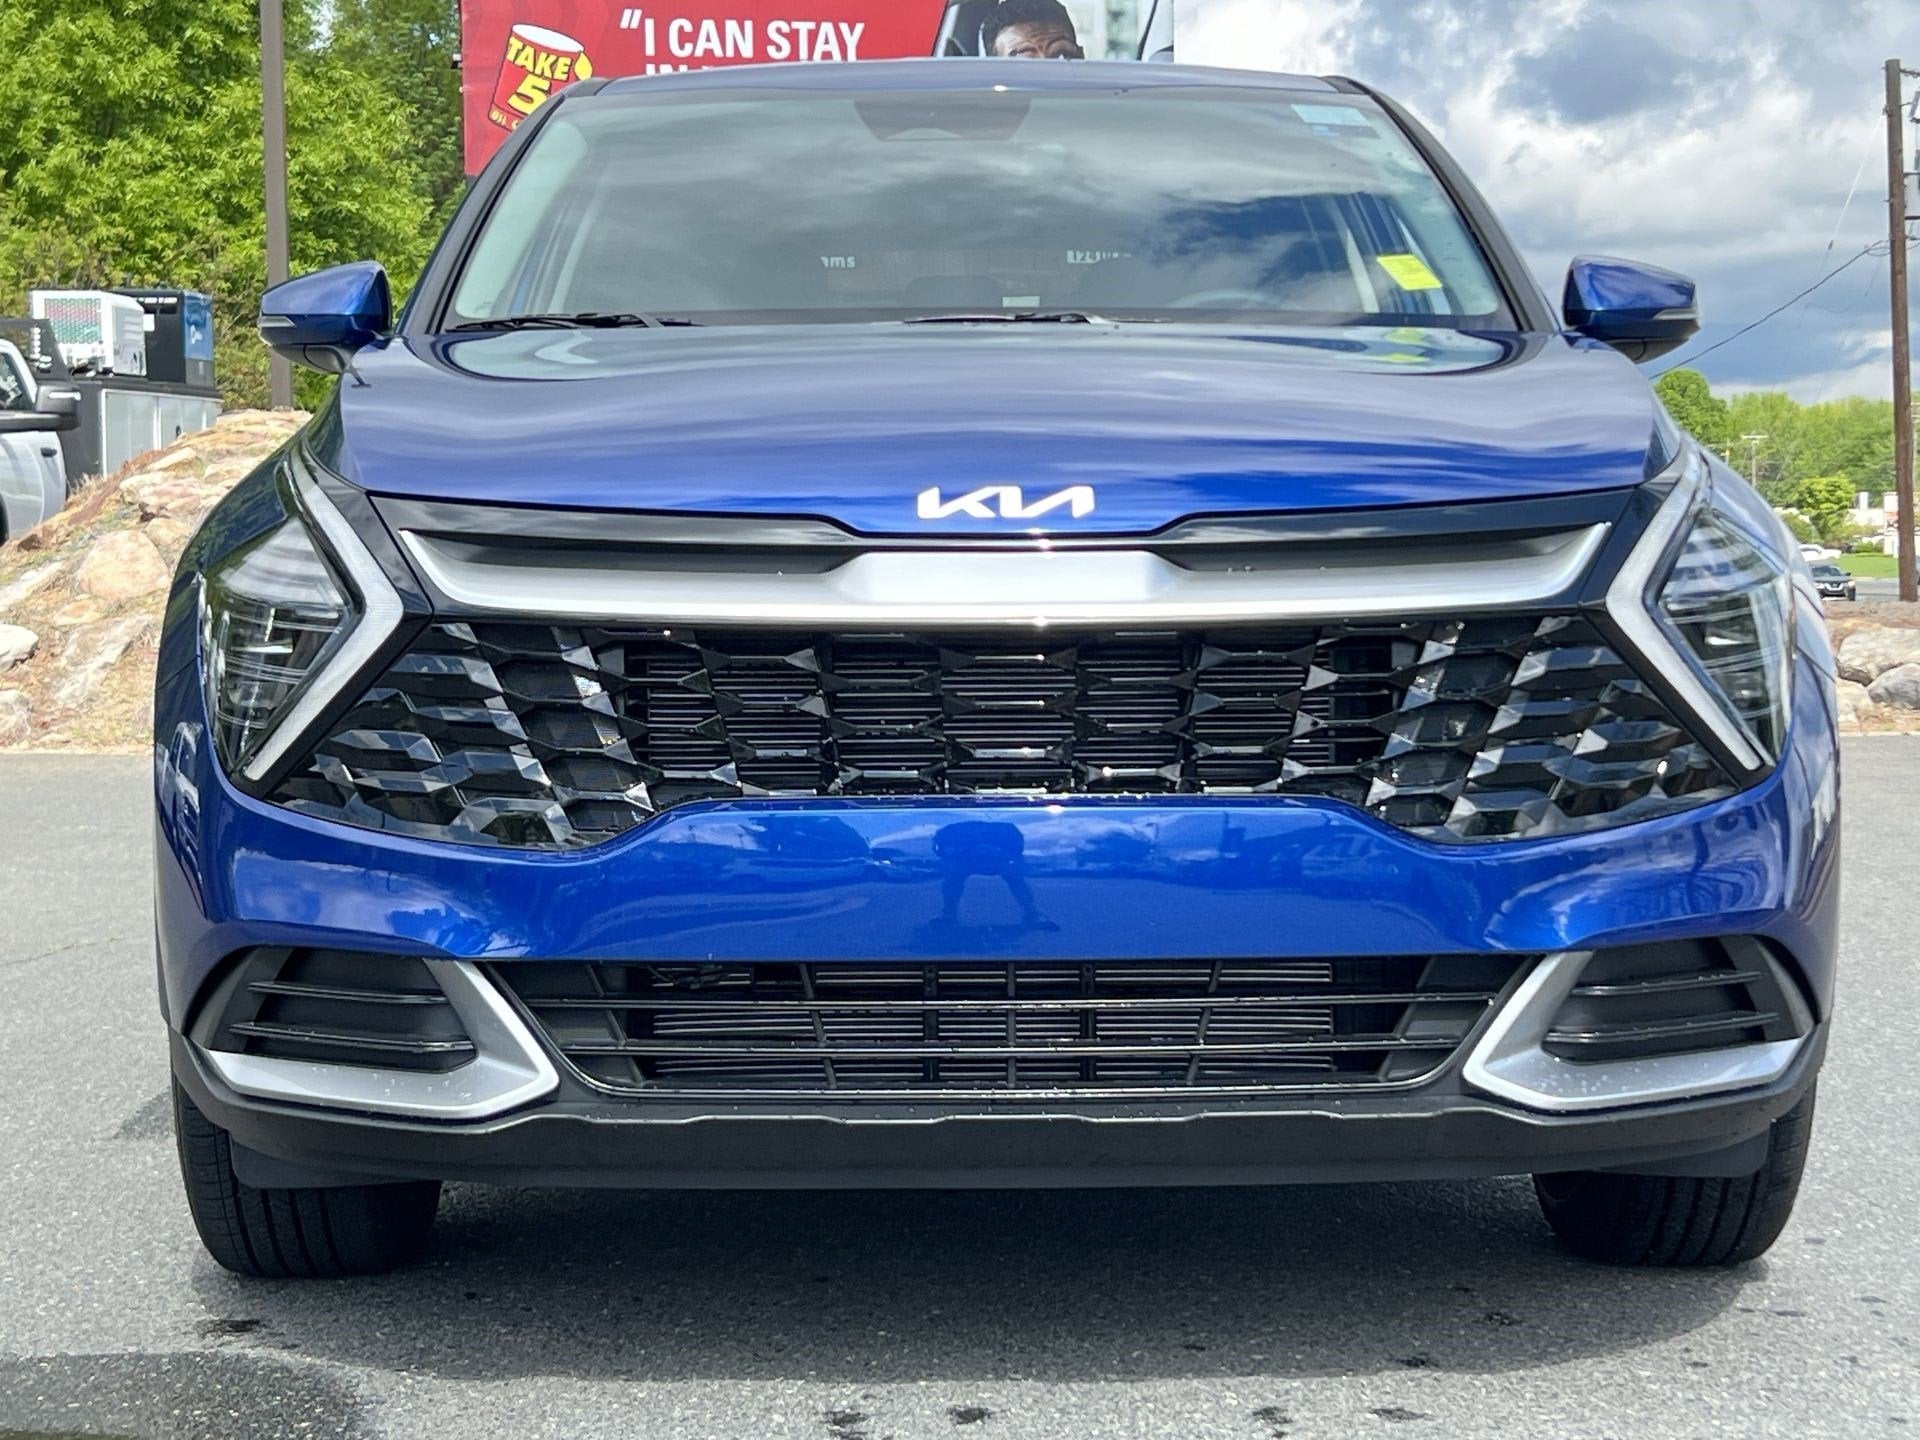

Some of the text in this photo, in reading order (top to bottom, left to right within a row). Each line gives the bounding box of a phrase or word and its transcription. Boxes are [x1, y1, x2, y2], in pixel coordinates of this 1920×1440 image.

[506, 36, 572, 81] TAKE
[668, 18, 754, 58] CAN
[766, 20, 865, 62] STAY
[507, 73, 551, 115] 5
[917, 485, 1095, 519] KIA
